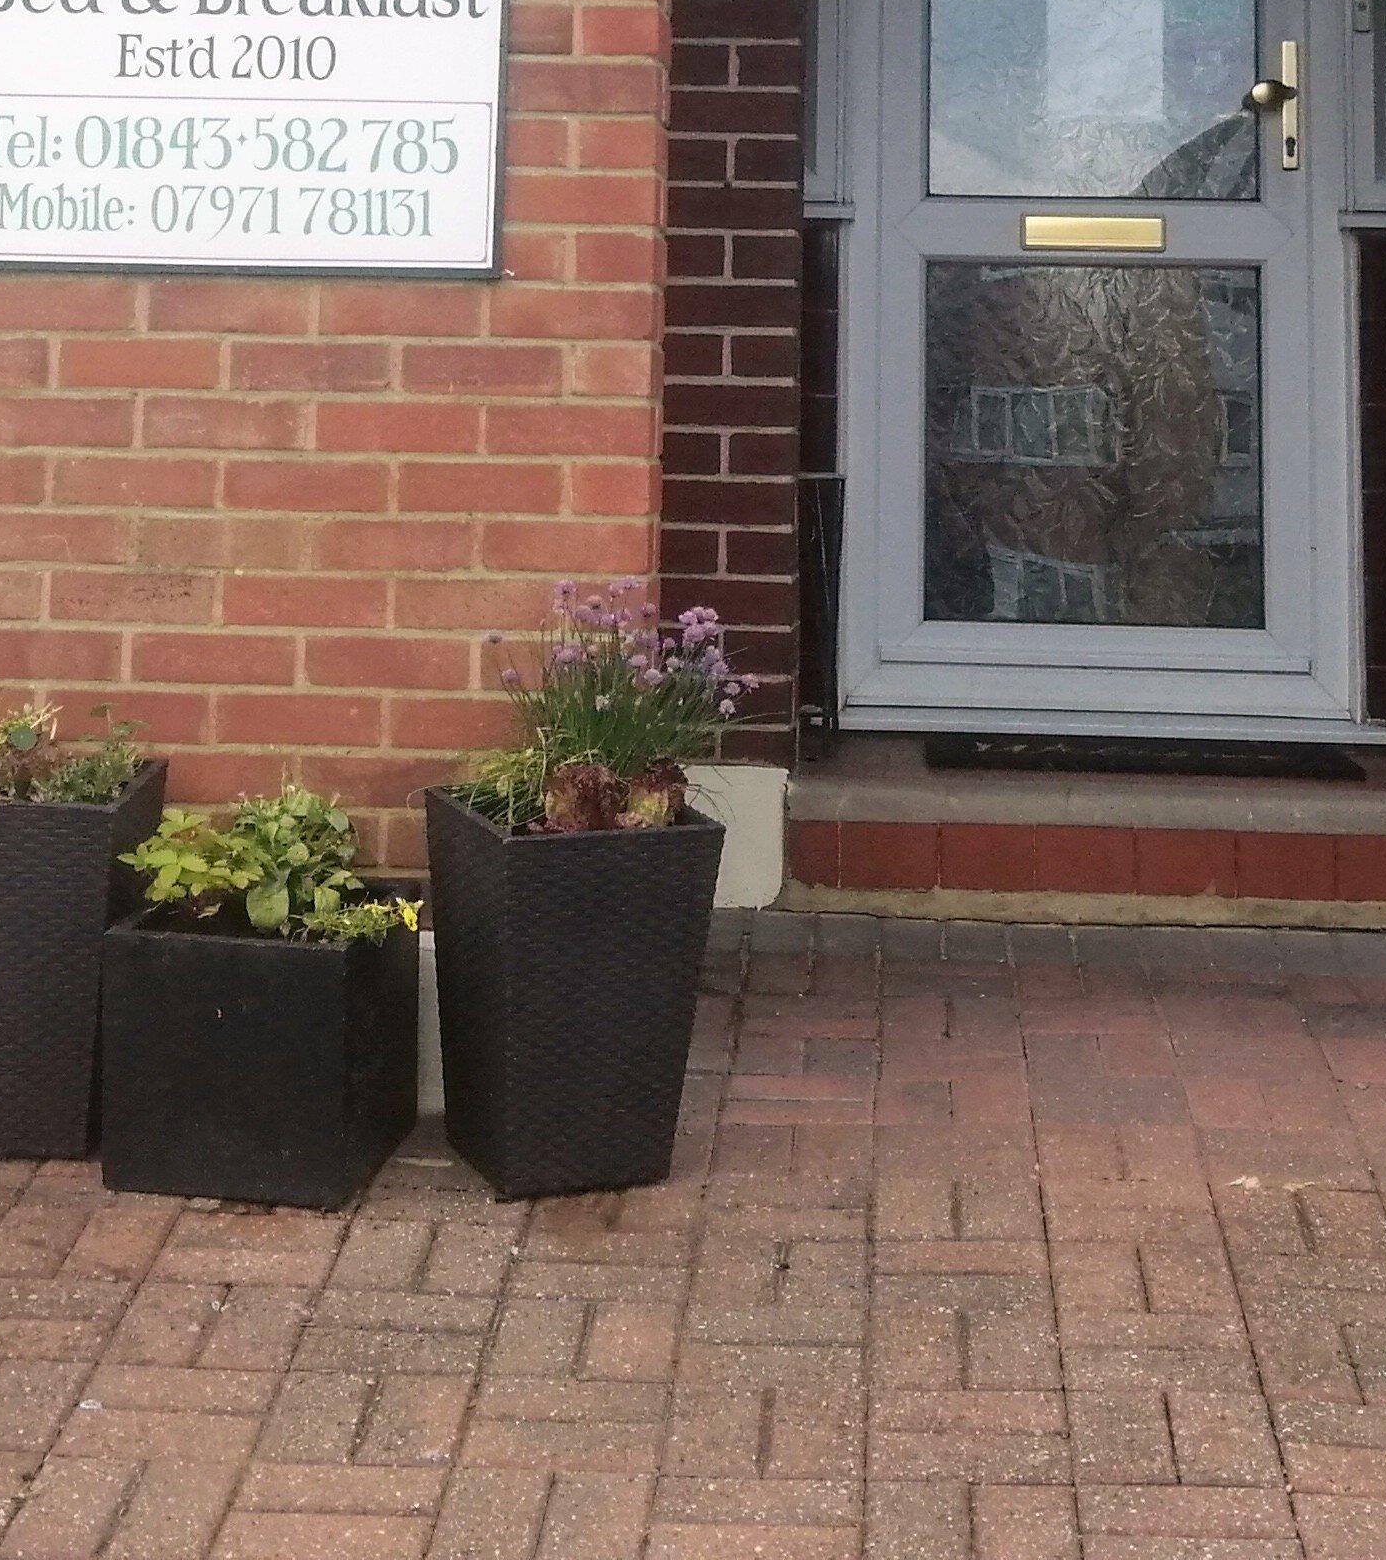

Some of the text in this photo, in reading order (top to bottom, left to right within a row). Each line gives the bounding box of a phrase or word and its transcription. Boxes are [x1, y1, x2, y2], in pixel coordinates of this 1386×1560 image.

[231, 35, 337, 81] 2010
[361, 118, 459, 176] 785
[150, 184, 281, 241] 07971
[298, 187, 432, 238] 781131
